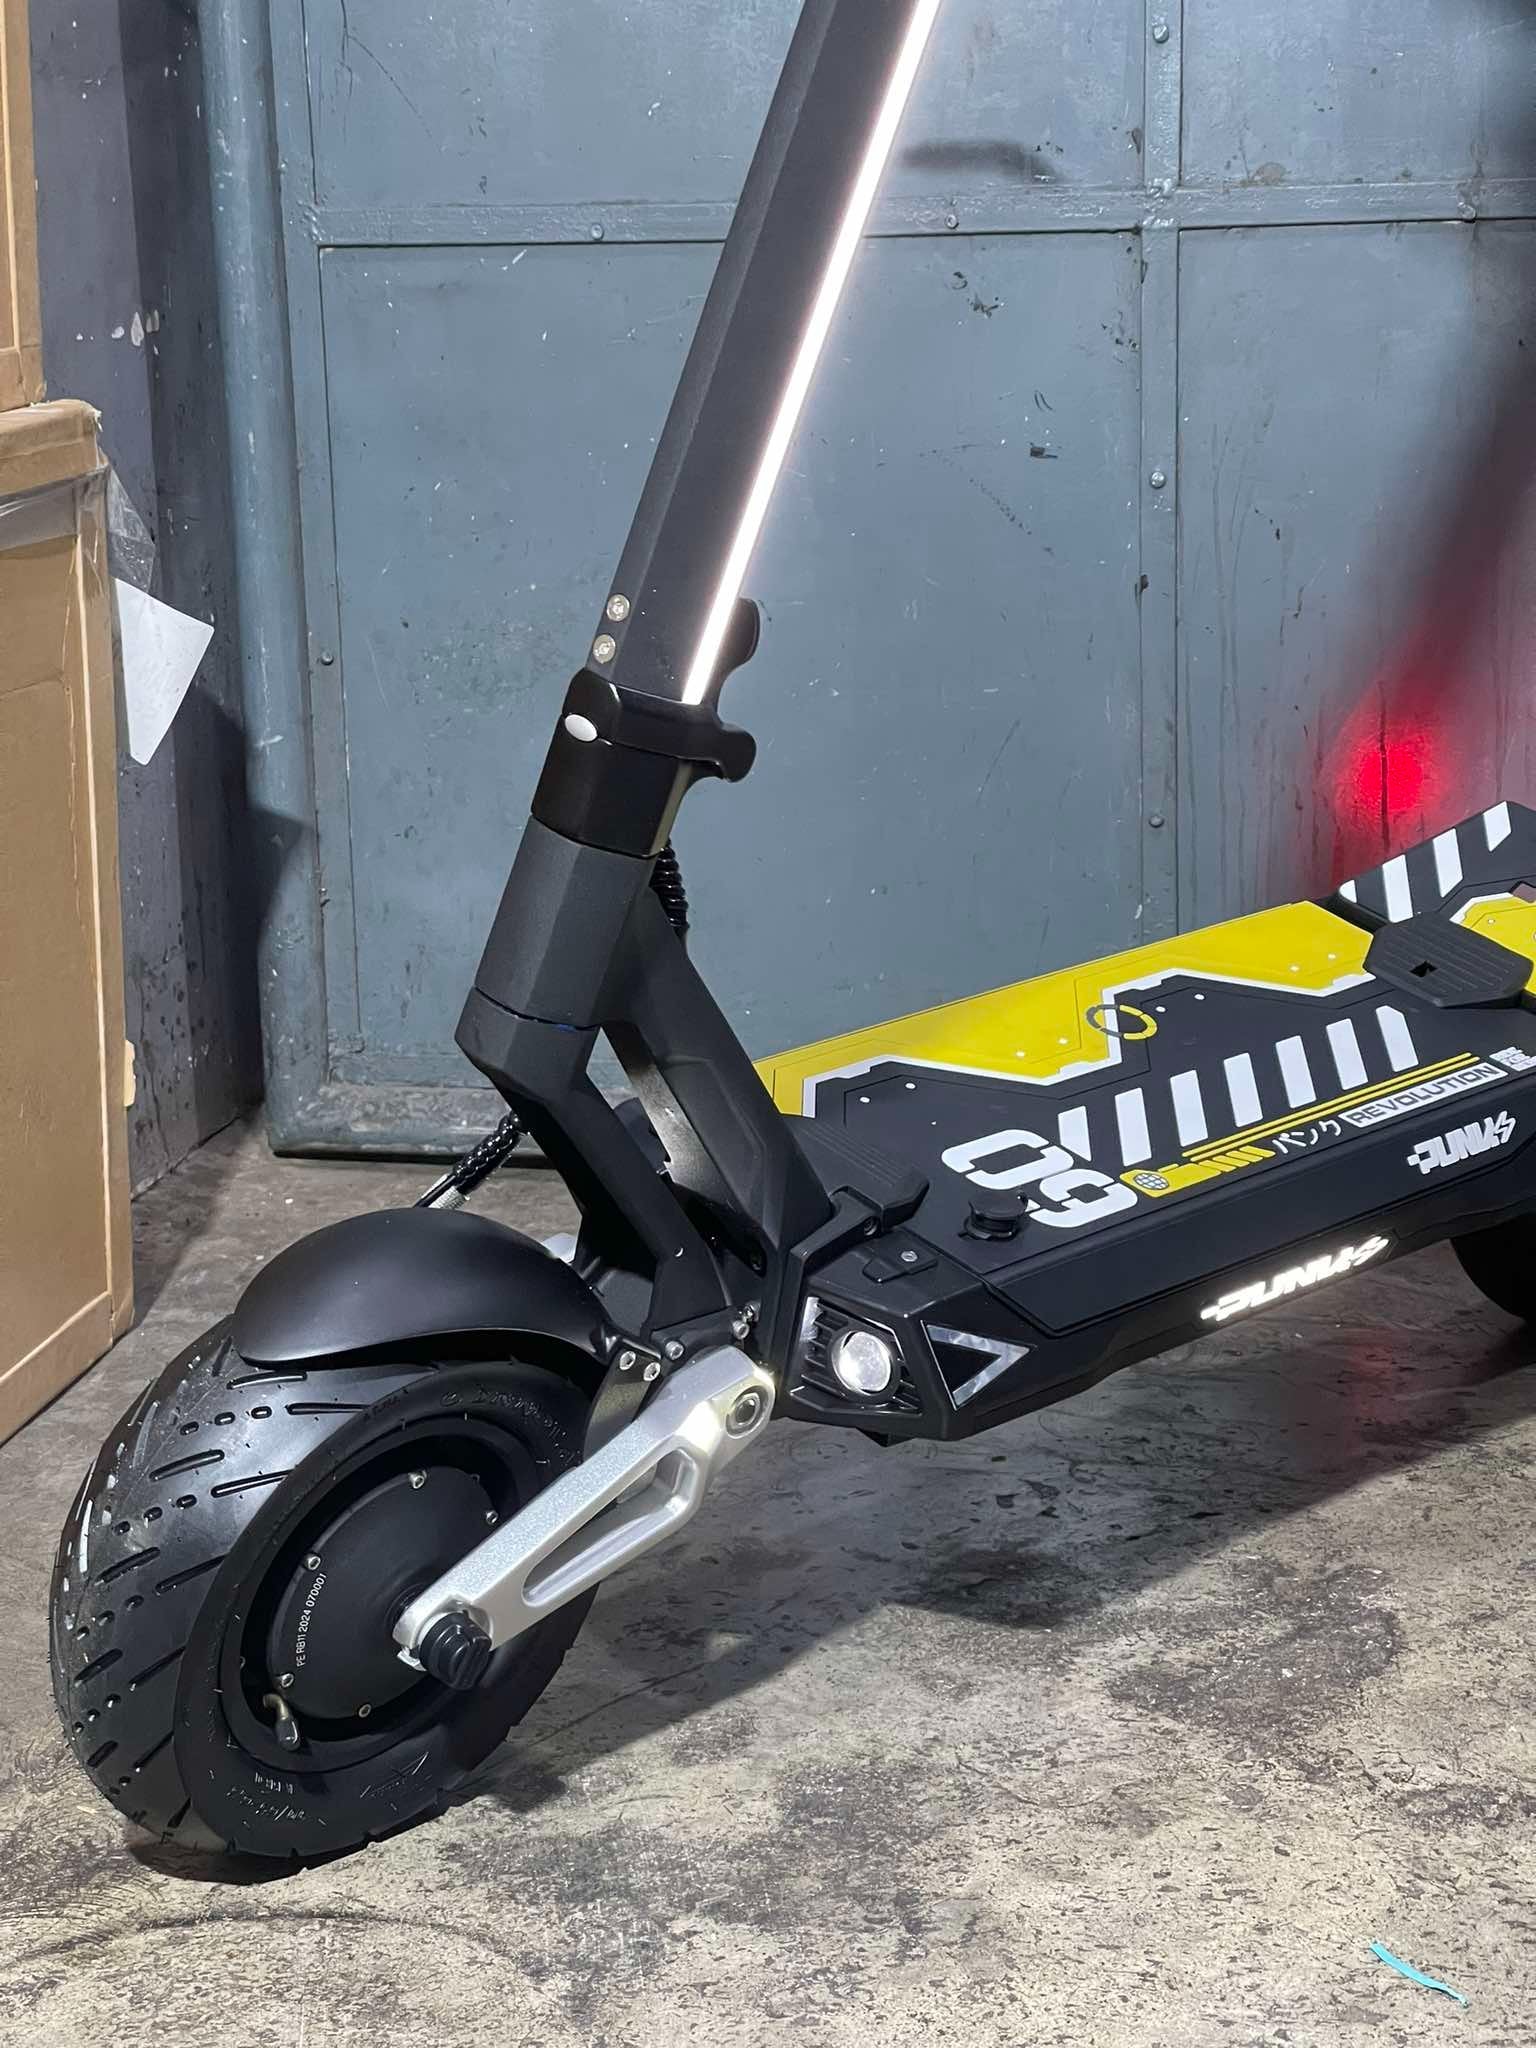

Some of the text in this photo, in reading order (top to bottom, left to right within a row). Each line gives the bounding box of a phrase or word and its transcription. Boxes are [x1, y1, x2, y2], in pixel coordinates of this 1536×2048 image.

[1345, 1064, 1501, 1124] REVOLUTION
[1272, 1119, 1341, 1154] パンク
[298, 1609, 312, 1632] 2024
[305, 1573, 327, 1607] 070001
